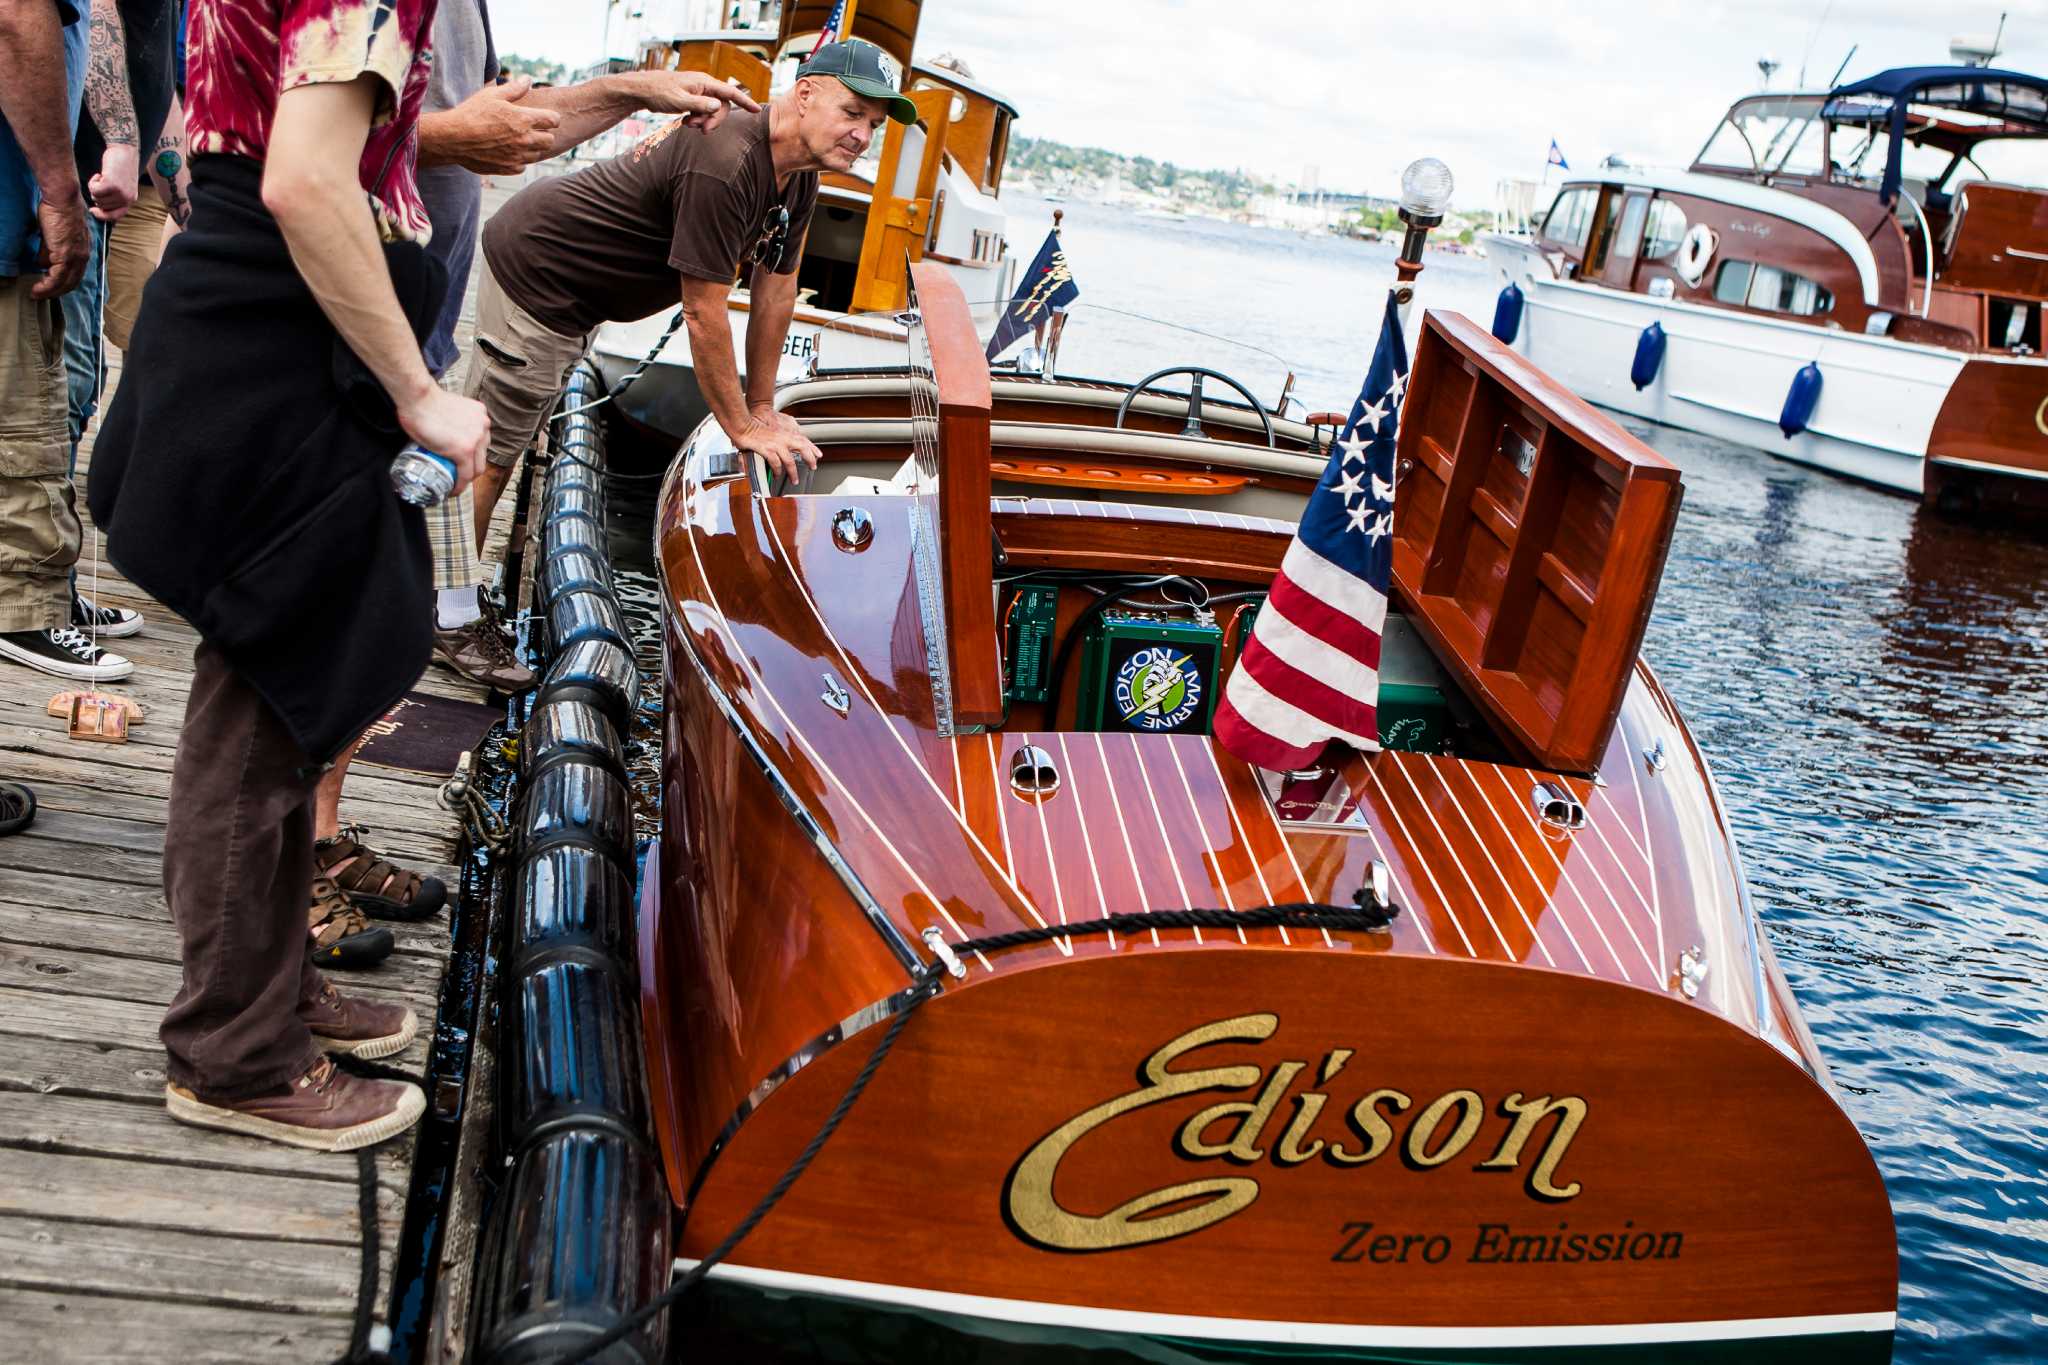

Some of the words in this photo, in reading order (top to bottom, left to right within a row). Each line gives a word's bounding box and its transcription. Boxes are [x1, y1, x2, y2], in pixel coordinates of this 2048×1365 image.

[1116, 647, 1173, 714] EDISON
[1141, 670, 1201, 729] MARINE
[1001, 1012, 1589, 1254] Edison
[1331, 1221, 1451, 1265] Zero
[1466, 1220, 1684, 1265] Emission
